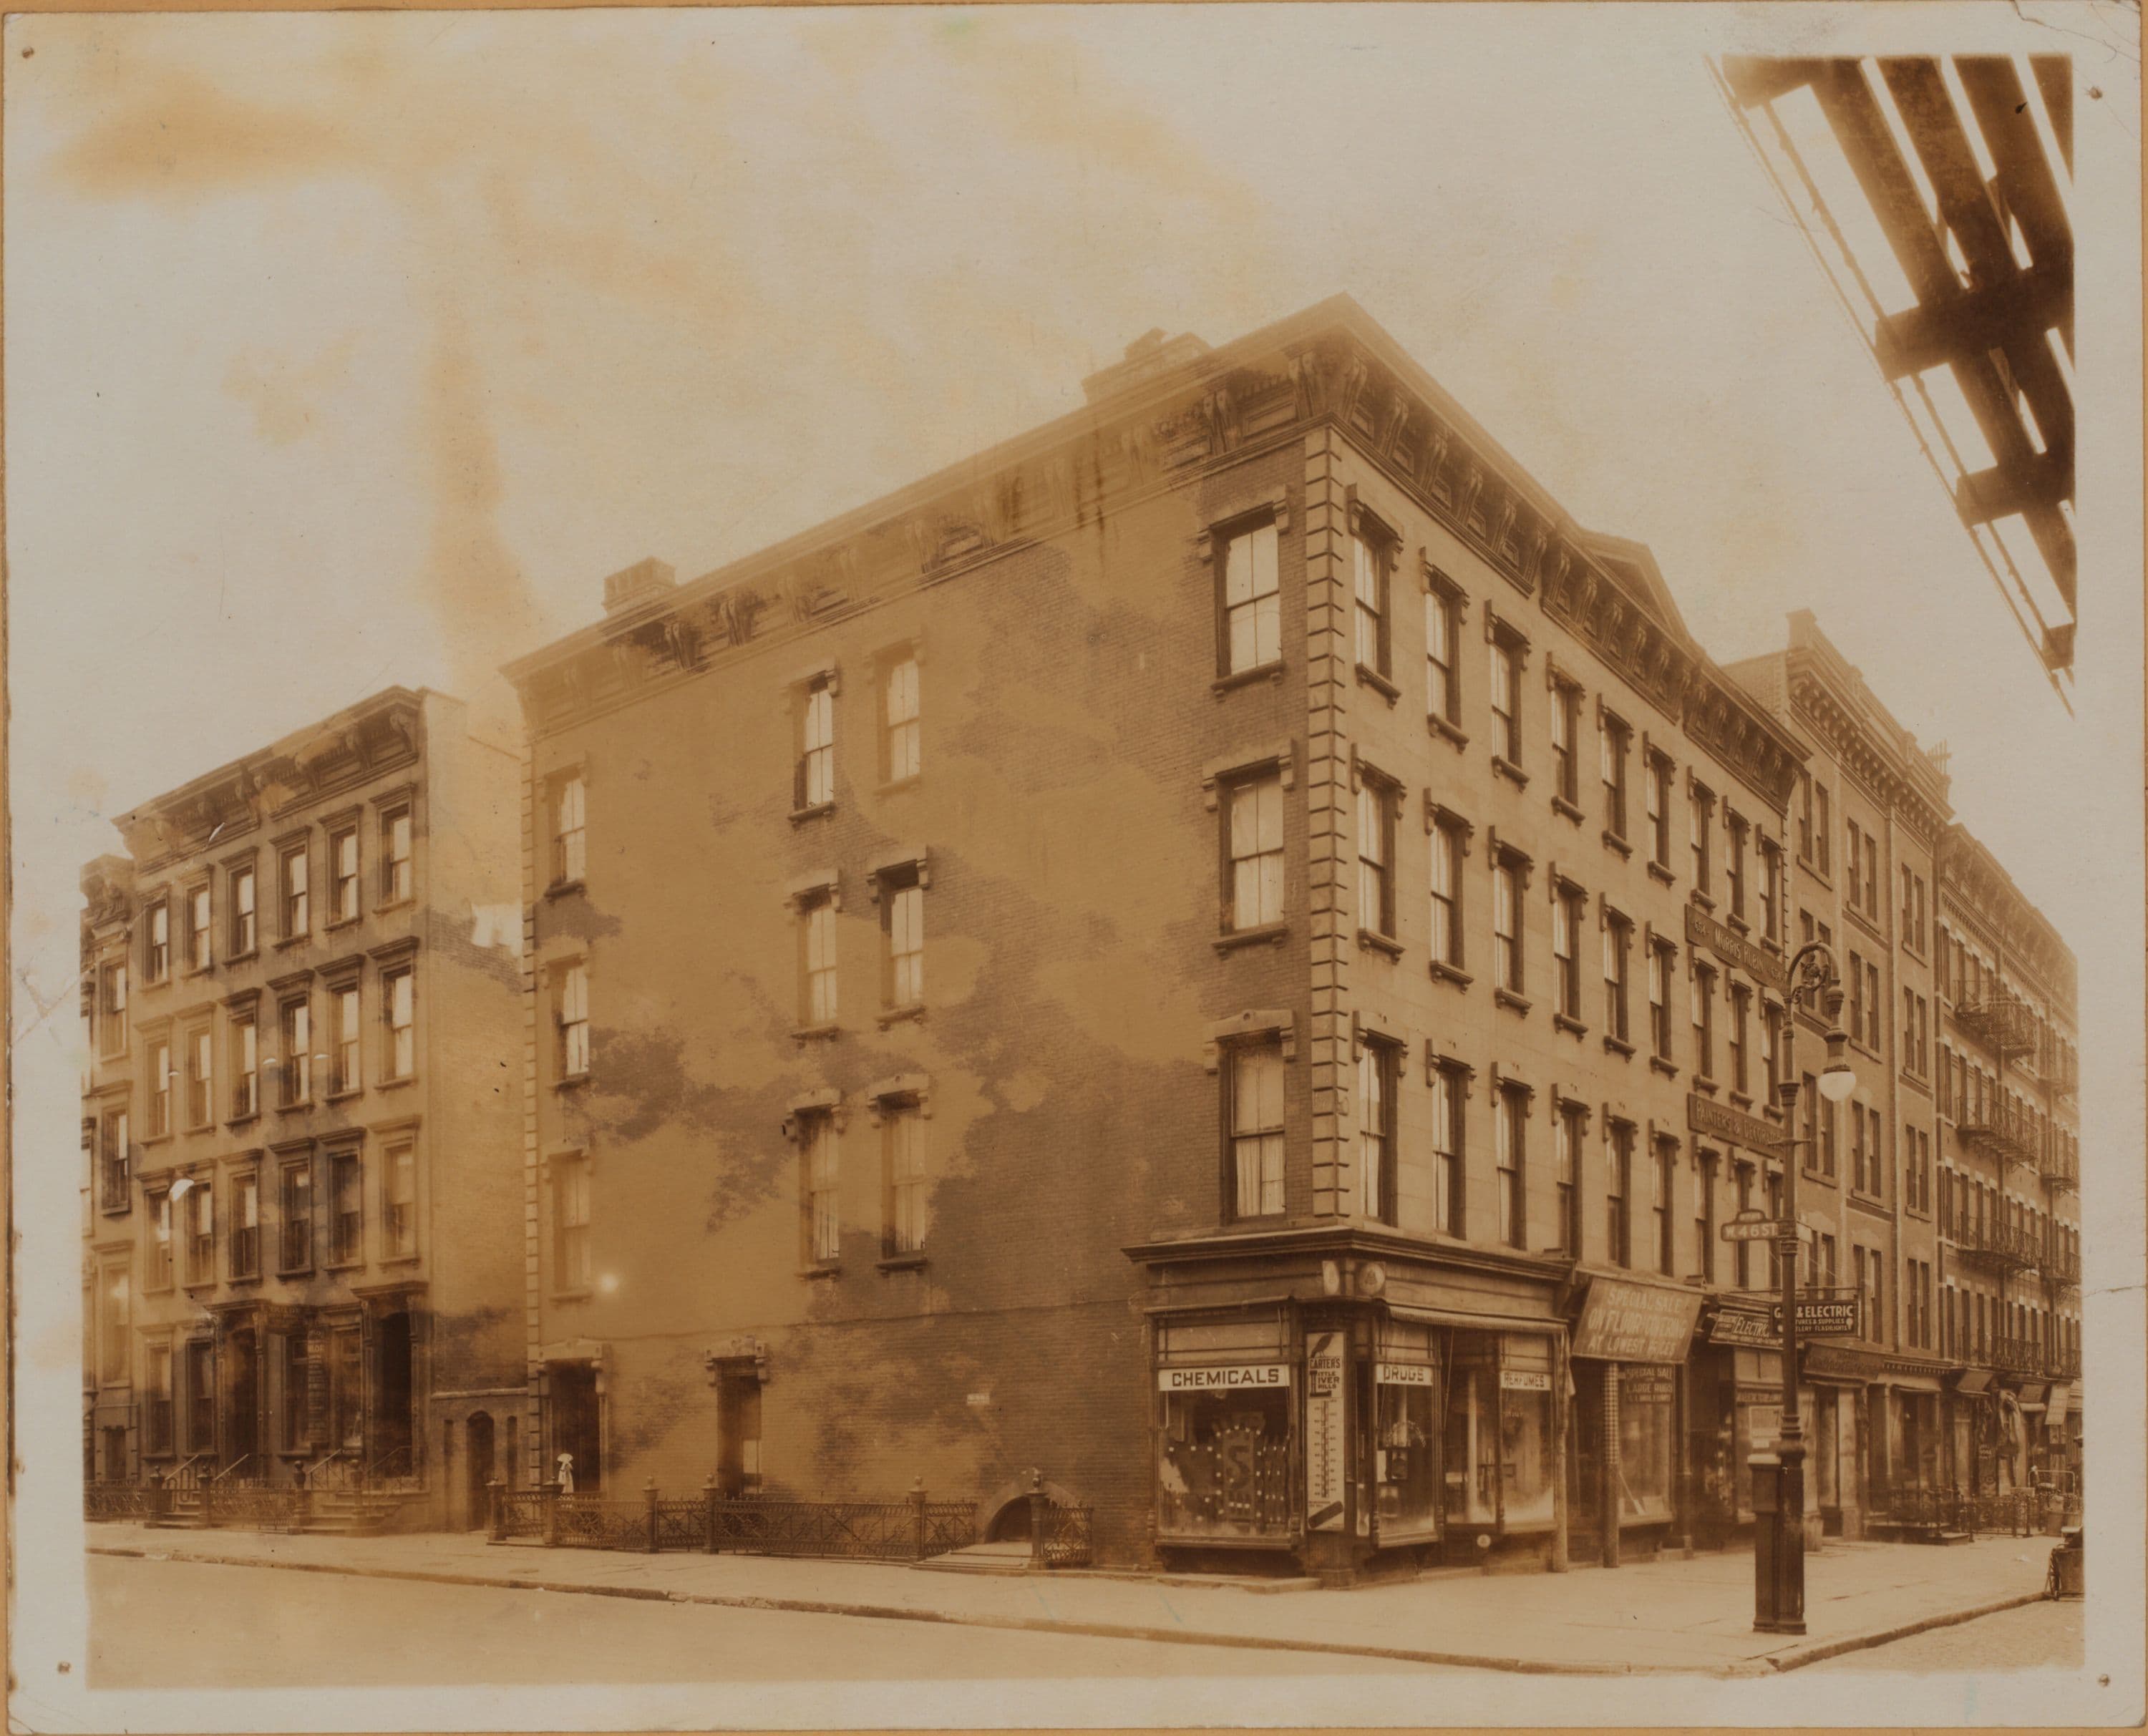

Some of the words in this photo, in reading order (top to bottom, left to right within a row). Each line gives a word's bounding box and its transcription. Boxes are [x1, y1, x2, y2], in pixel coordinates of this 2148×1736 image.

[1715, 927, 1741, 960] MORRIS
[1744, 945, 1764, 973] RUBIN
[1696, 1101, 1731, 1131] PAINTERS
[1739, 1224, 1759, 1237] 46
[1608, 1285, 1654, 1310] SPECIAL
[1805, 1305, 1853, 1317] ELECTRIC
[1588, 1307, 1606, 1330] ON
[1605, 1310, 1643, 1334] FLOOR
[1588, 1335, 1604, 1352] AT
[1608, 1336, 1646, 1353] LOWEST
[1172, 1368, 1279, 1387] CHEMICALS
[1384, 1365, 1424, 1382] DRUGS
[1505, 1372, 1545, 1388] PERFUMES
